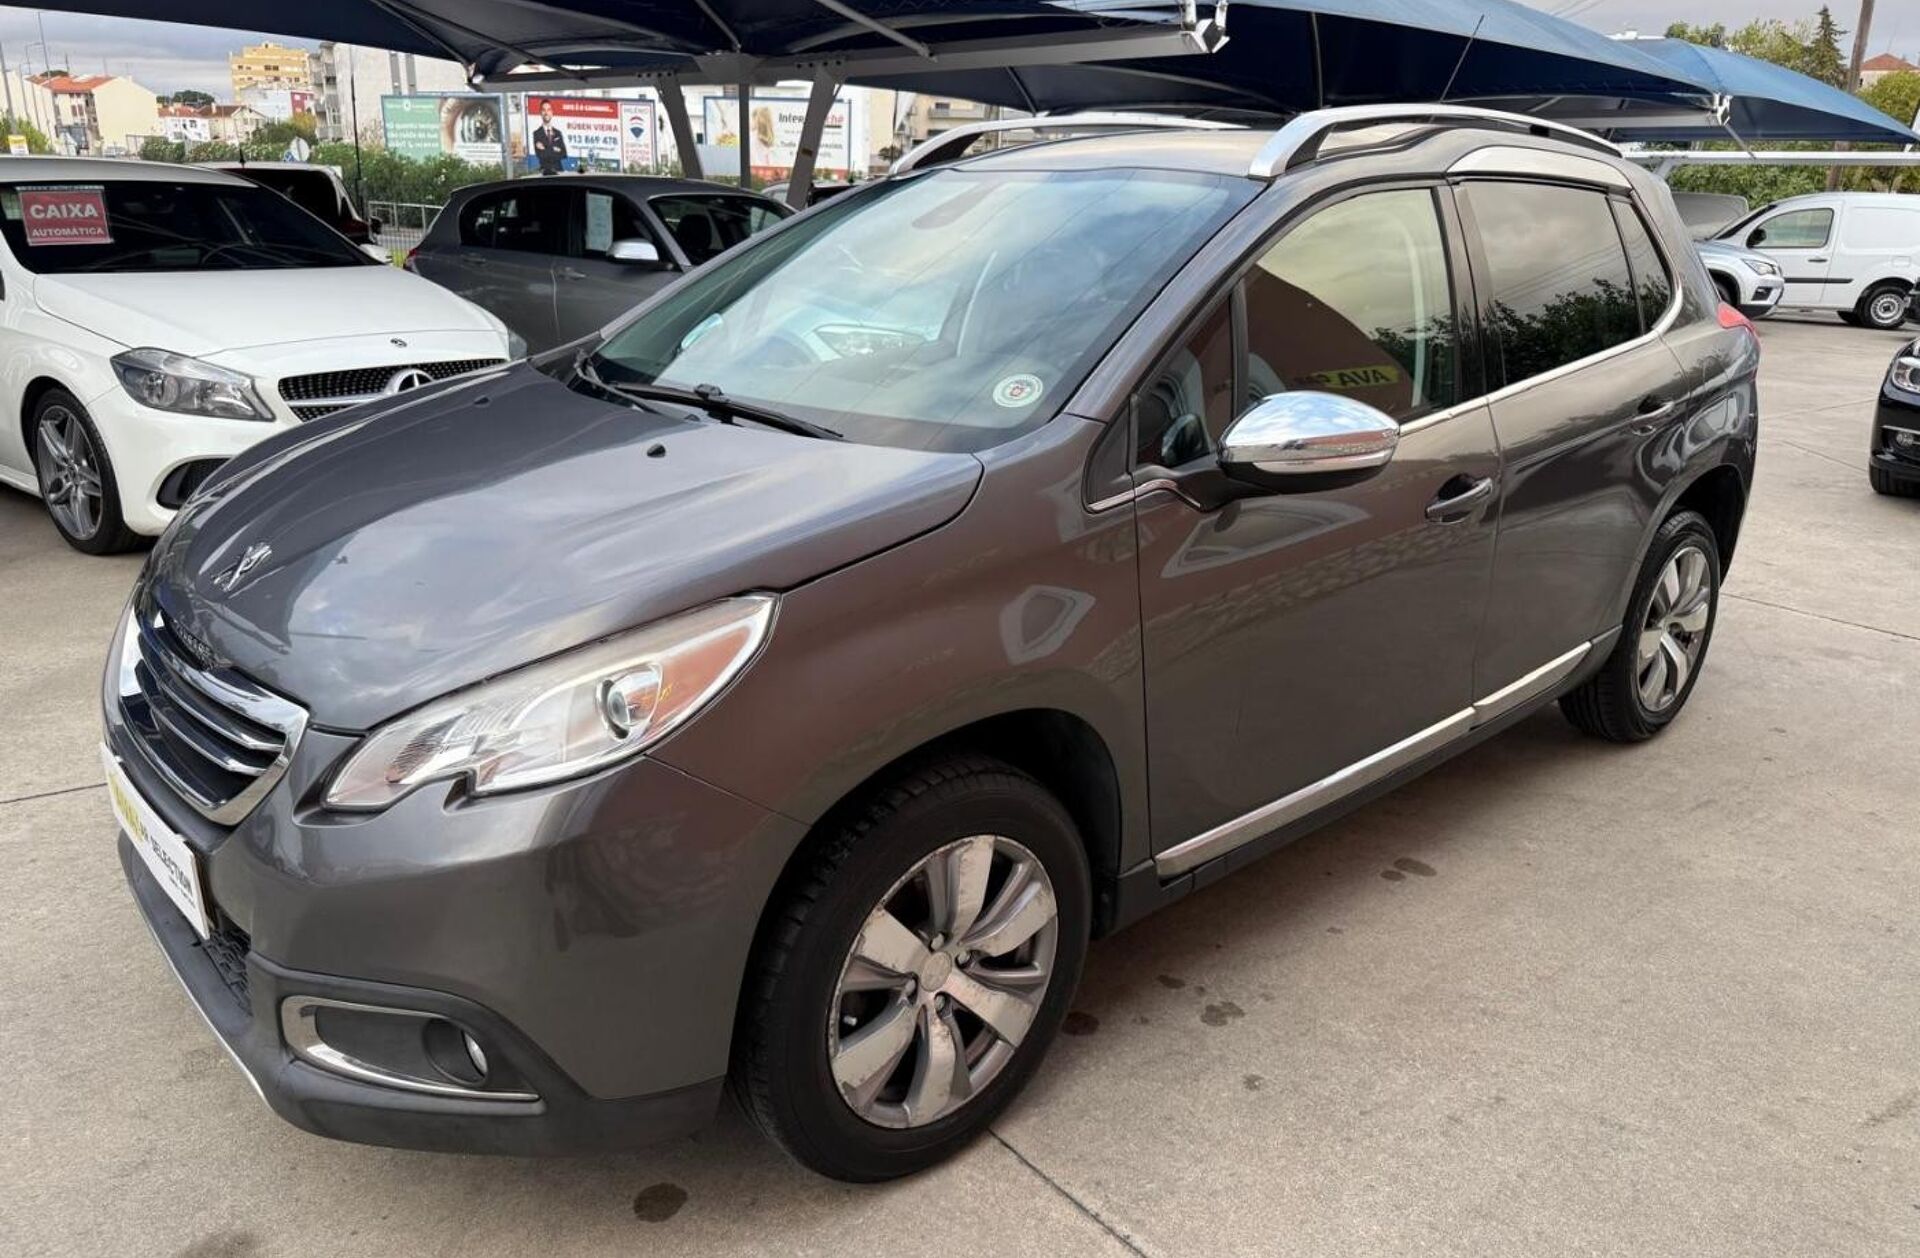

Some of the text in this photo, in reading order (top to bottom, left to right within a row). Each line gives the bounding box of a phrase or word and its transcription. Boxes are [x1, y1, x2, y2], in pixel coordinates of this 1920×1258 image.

[568, 135, 582, 144] 913
[29, 202, 99, 218] CAIXA
[31, 225, 105, 237] AUTOMÁTICA
[149, 833, 194, 899] SELECTION
